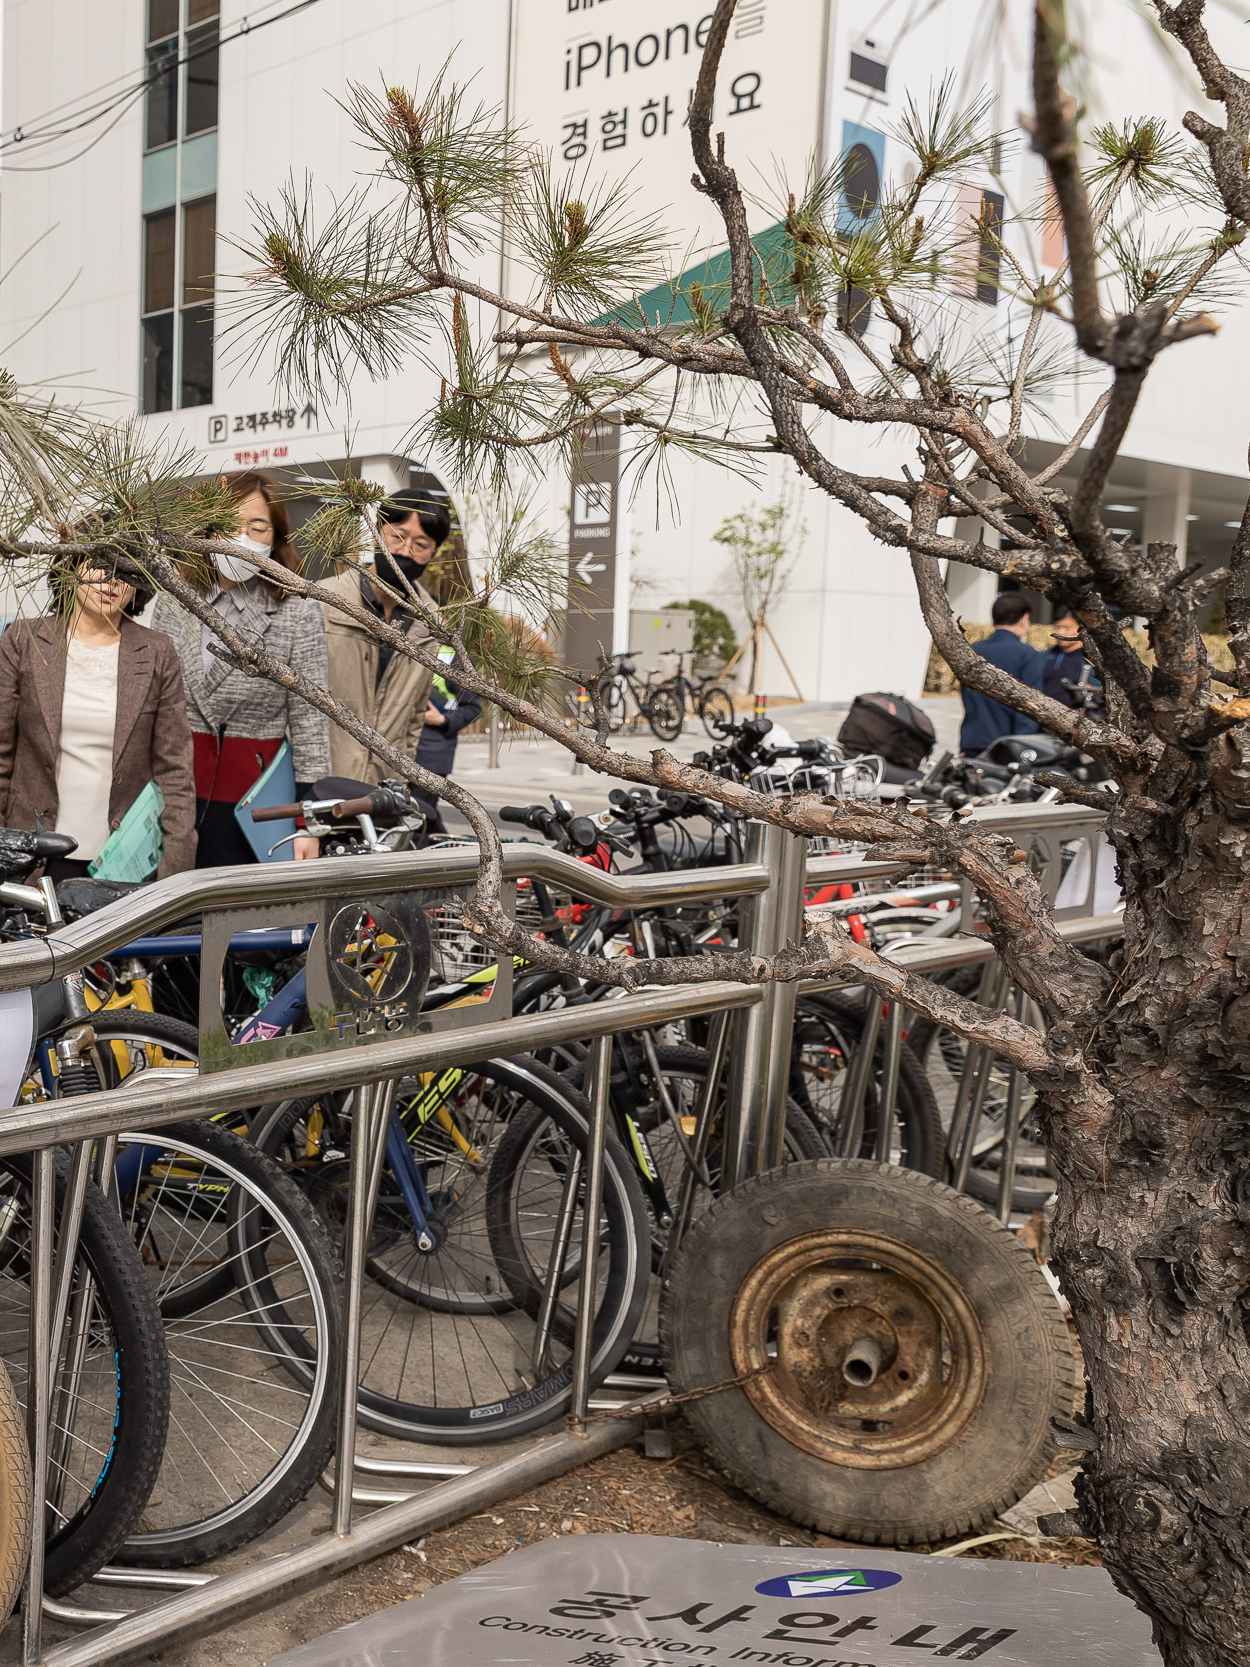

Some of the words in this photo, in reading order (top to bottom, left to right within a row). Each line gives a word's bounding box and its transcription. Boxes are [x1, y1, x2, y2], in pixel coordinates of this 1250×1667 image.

[232, 408, 296, 434] 고객주차장
[573, 527, 611, 540] PARKING
[478, 1616, 718, 1654] Construction
